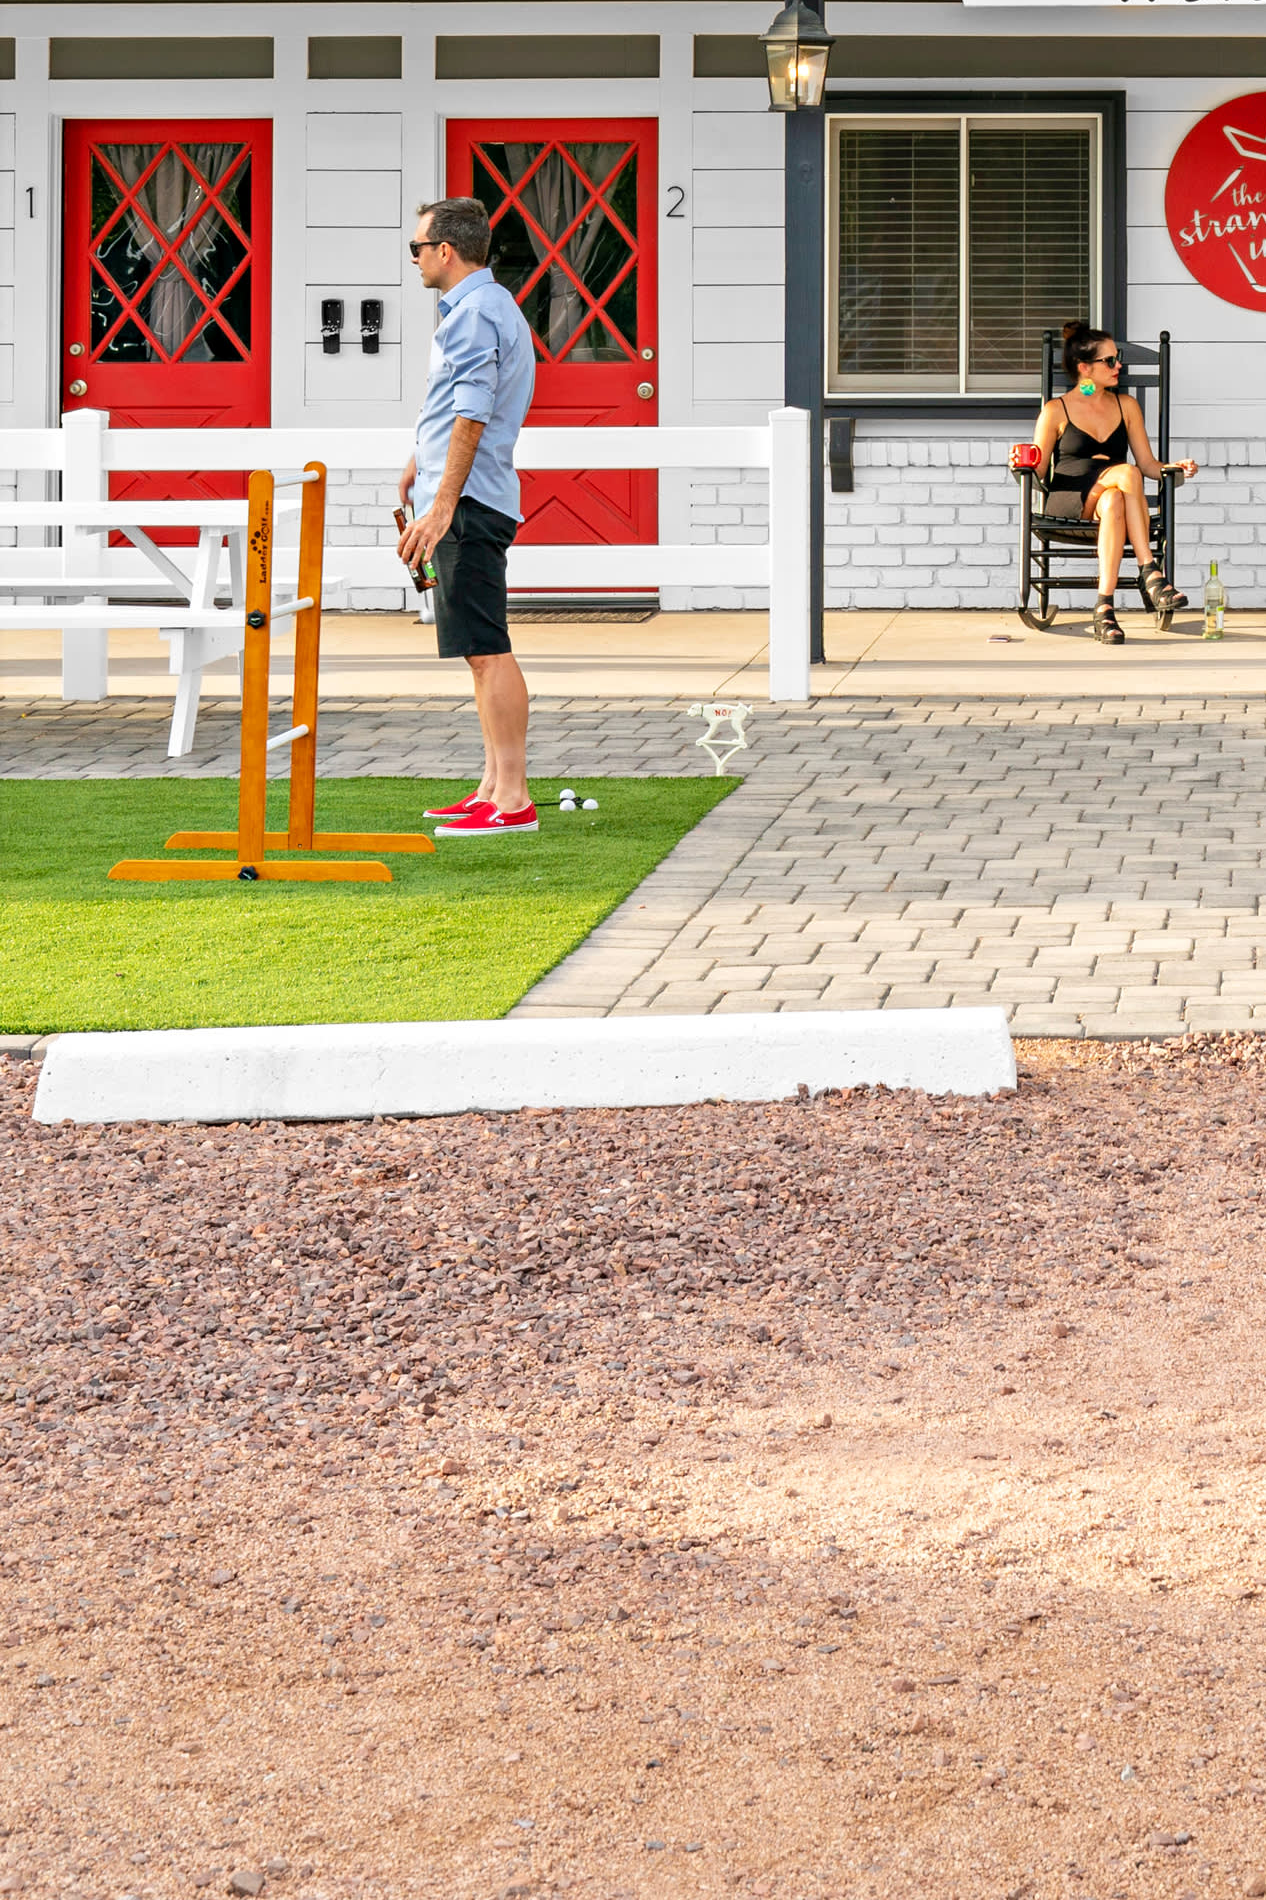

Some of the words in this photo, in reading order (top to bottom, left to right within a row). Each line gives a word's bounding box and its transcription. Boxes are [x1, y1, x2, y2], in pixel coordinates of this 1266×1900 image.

[25, 187, 34, 218] 1
[666, 185, 685, 218] 2
[1231, 182, 1266, 207] the
